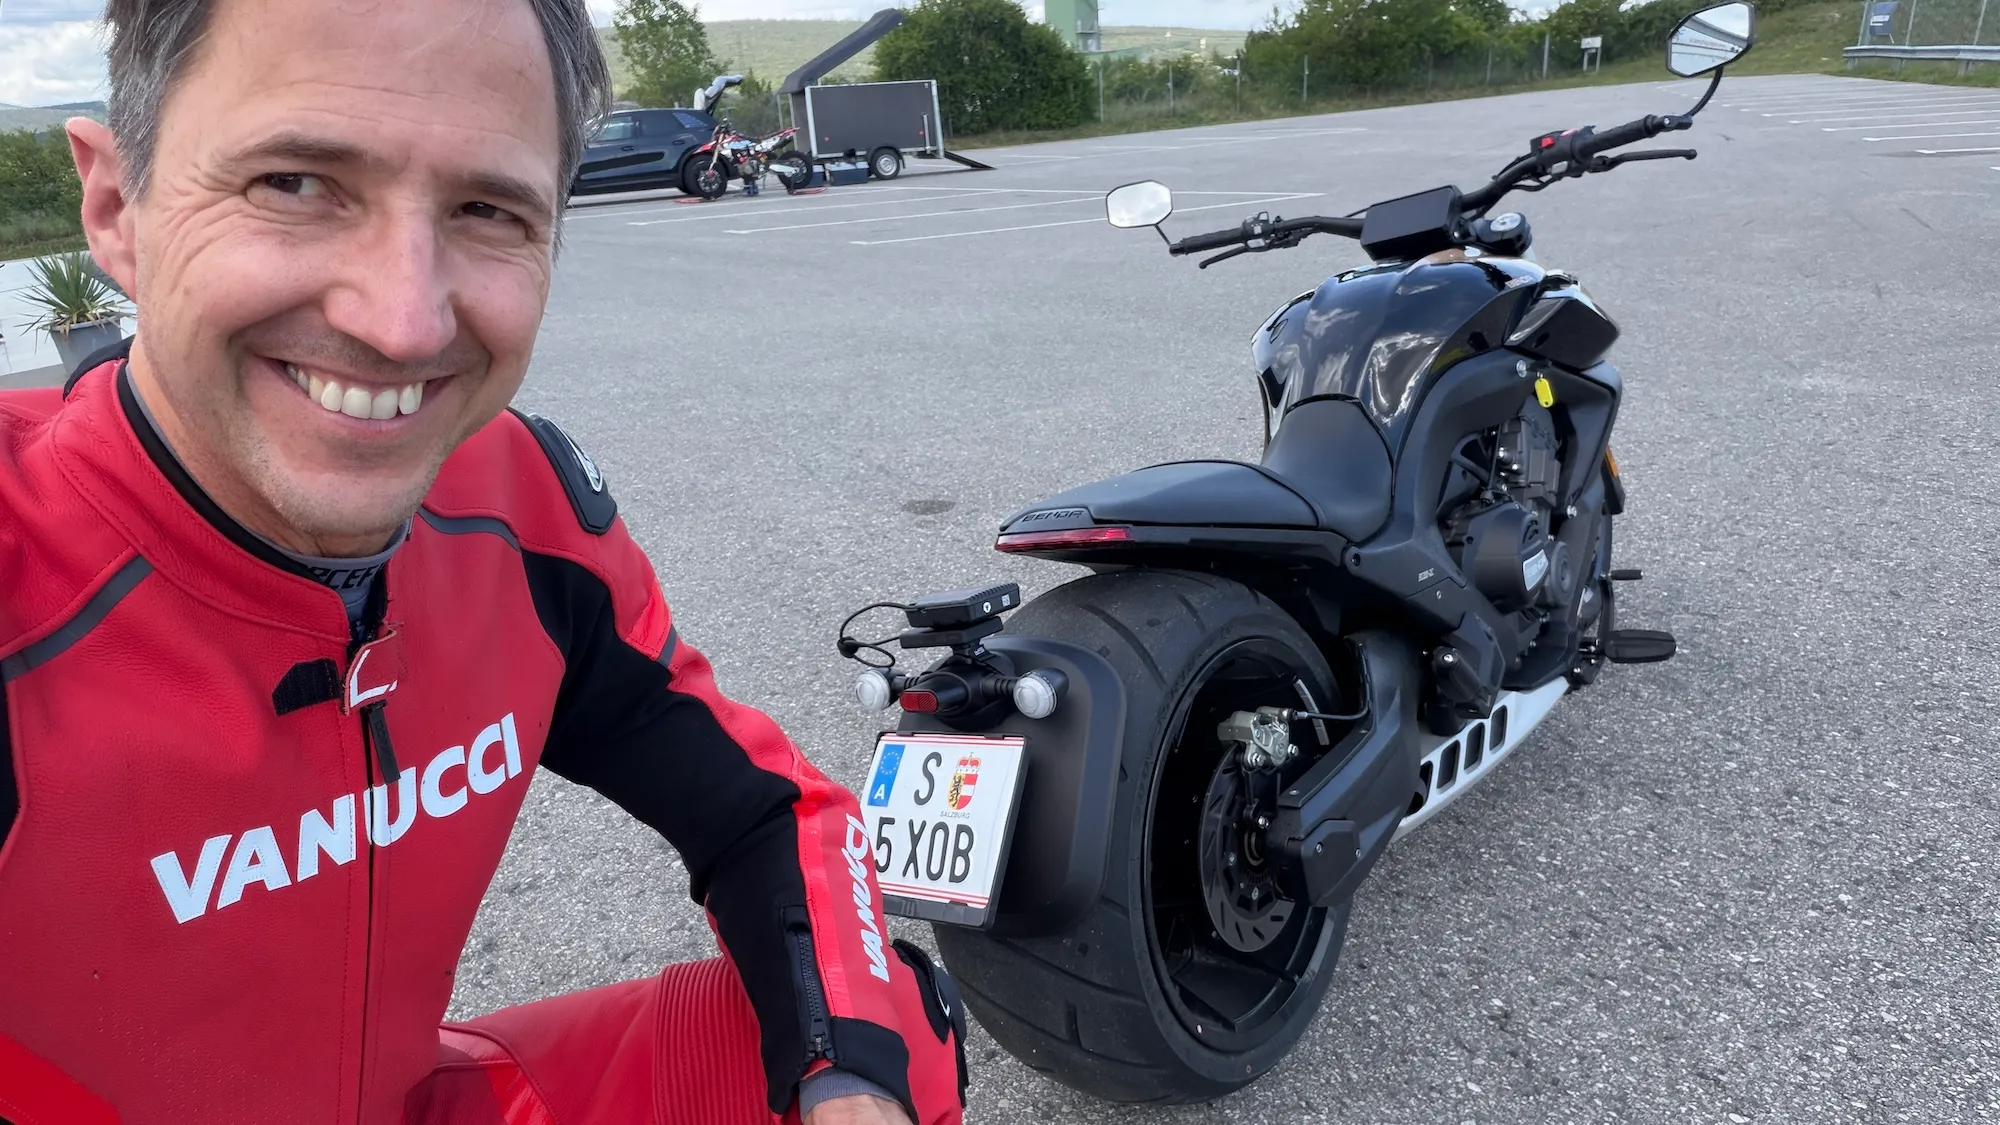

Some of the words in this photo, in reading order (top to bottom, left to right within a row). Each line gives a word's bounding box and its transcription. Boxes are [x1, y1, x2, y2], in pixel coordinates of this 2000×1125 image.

[873, 785, 886, 800] A
[913, 751, 943, 806] S
[150, 712, 522, 924] VANUCCI
[939, 810, 971, 819] SALZBURG
[875, 816, 896, 873] 5
[902, 818, 975, 884] XOB
